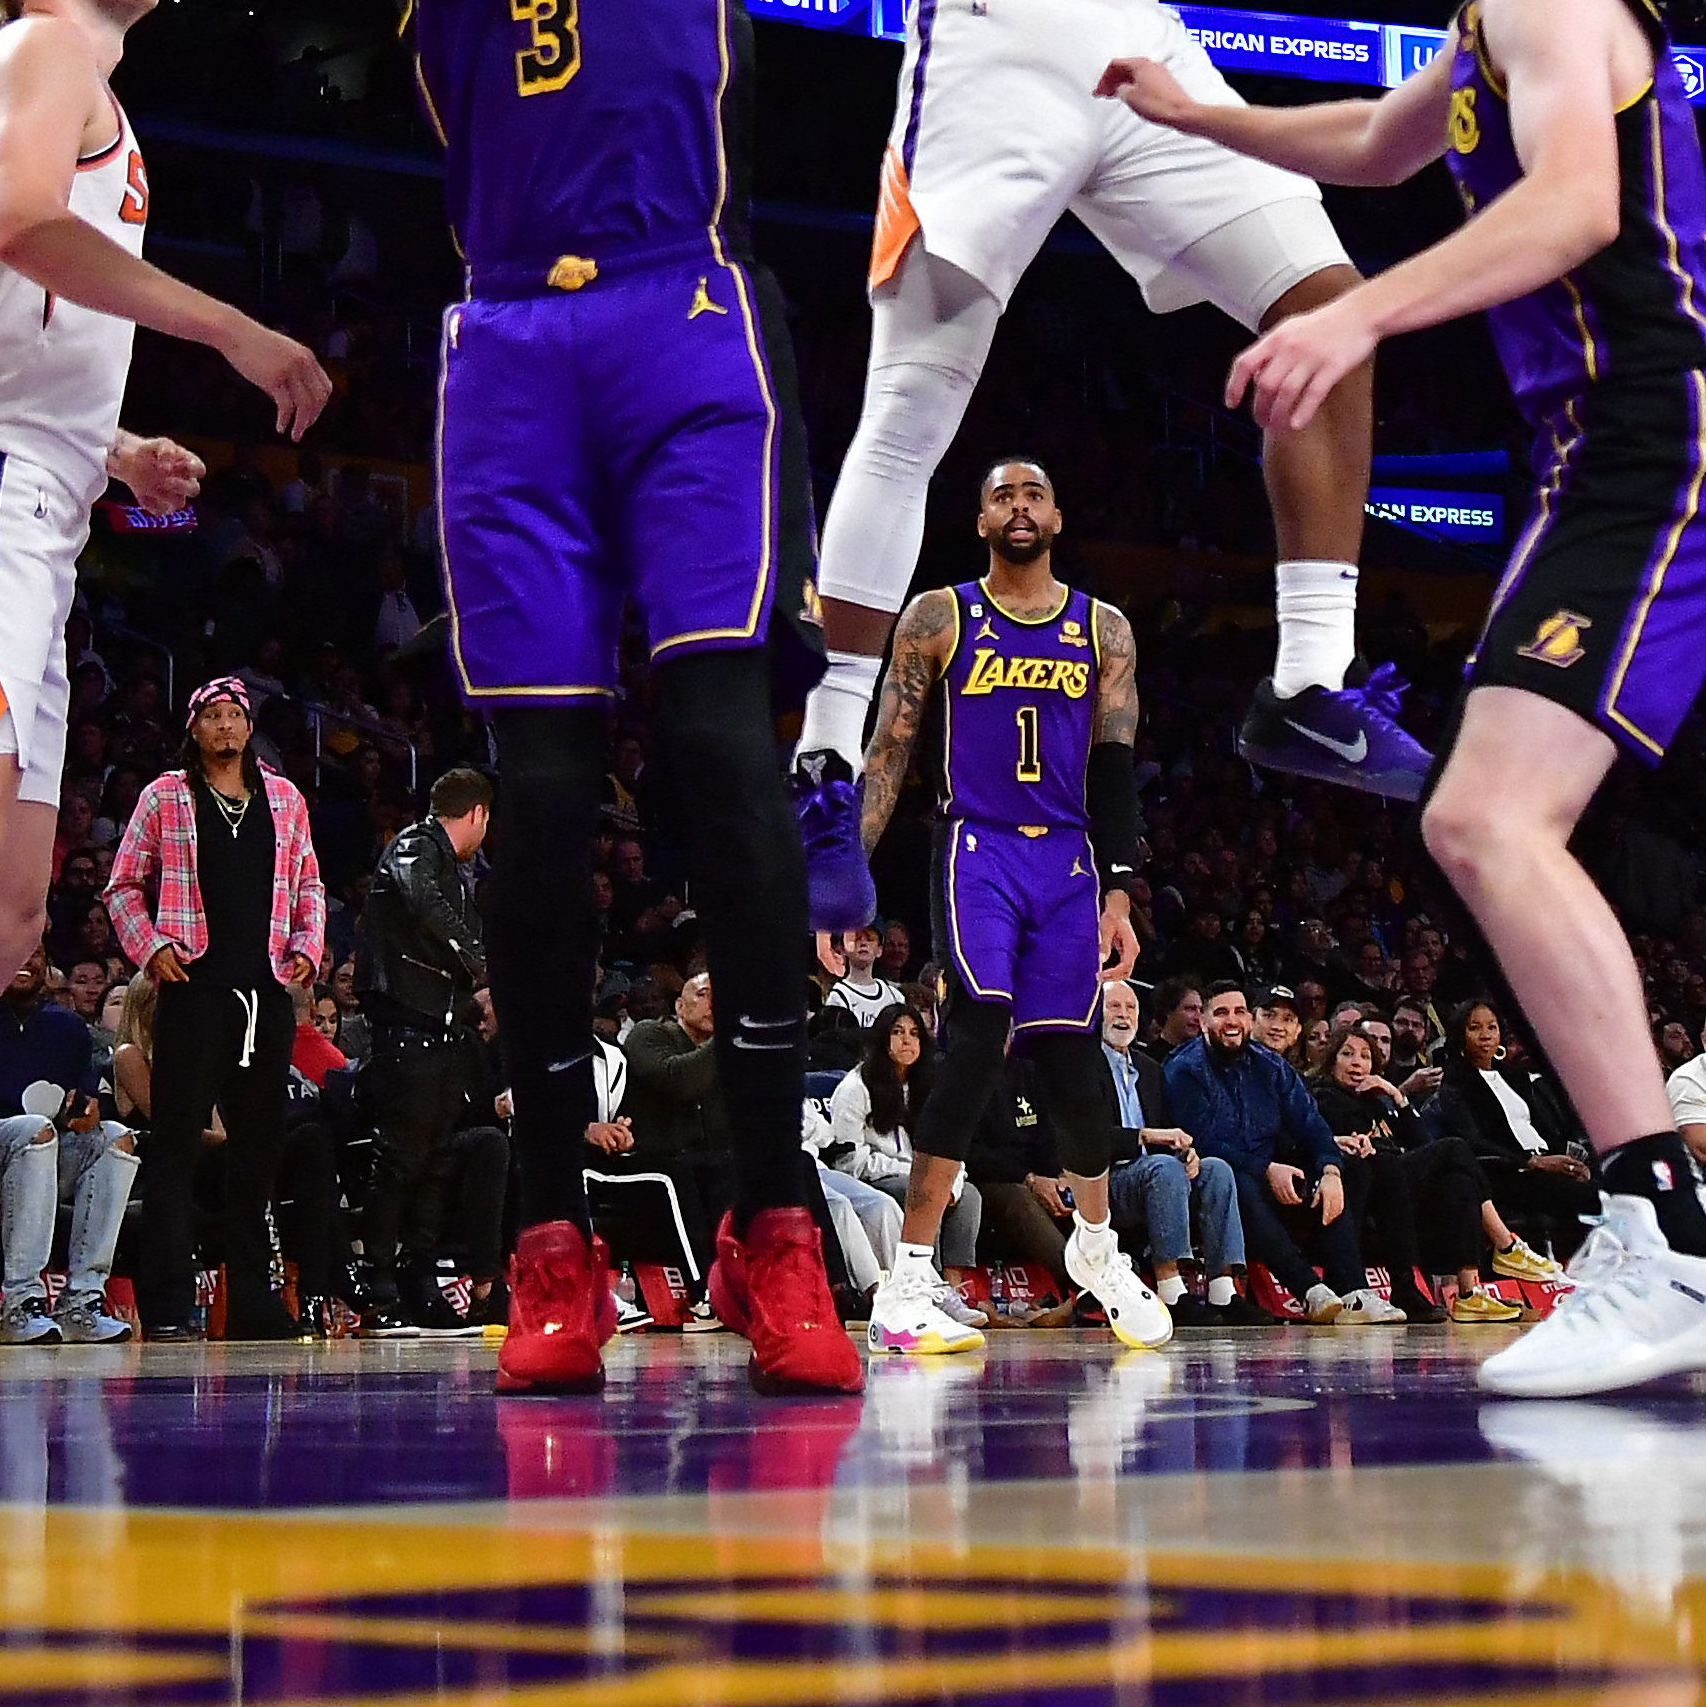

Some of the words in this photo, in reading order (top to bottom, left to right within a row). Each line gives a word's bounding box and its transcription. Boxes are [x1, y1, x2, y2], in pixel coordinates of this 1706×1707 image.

[1188, 27, 1265, 53] ERICAN
[1270, 36, 1370, 63] EXPRESS
[1411, 504, 1494, 527] EXPRESS
[961, 648, 1088, 700] LAKERS
[1016, 704, 1041, 783] 1
